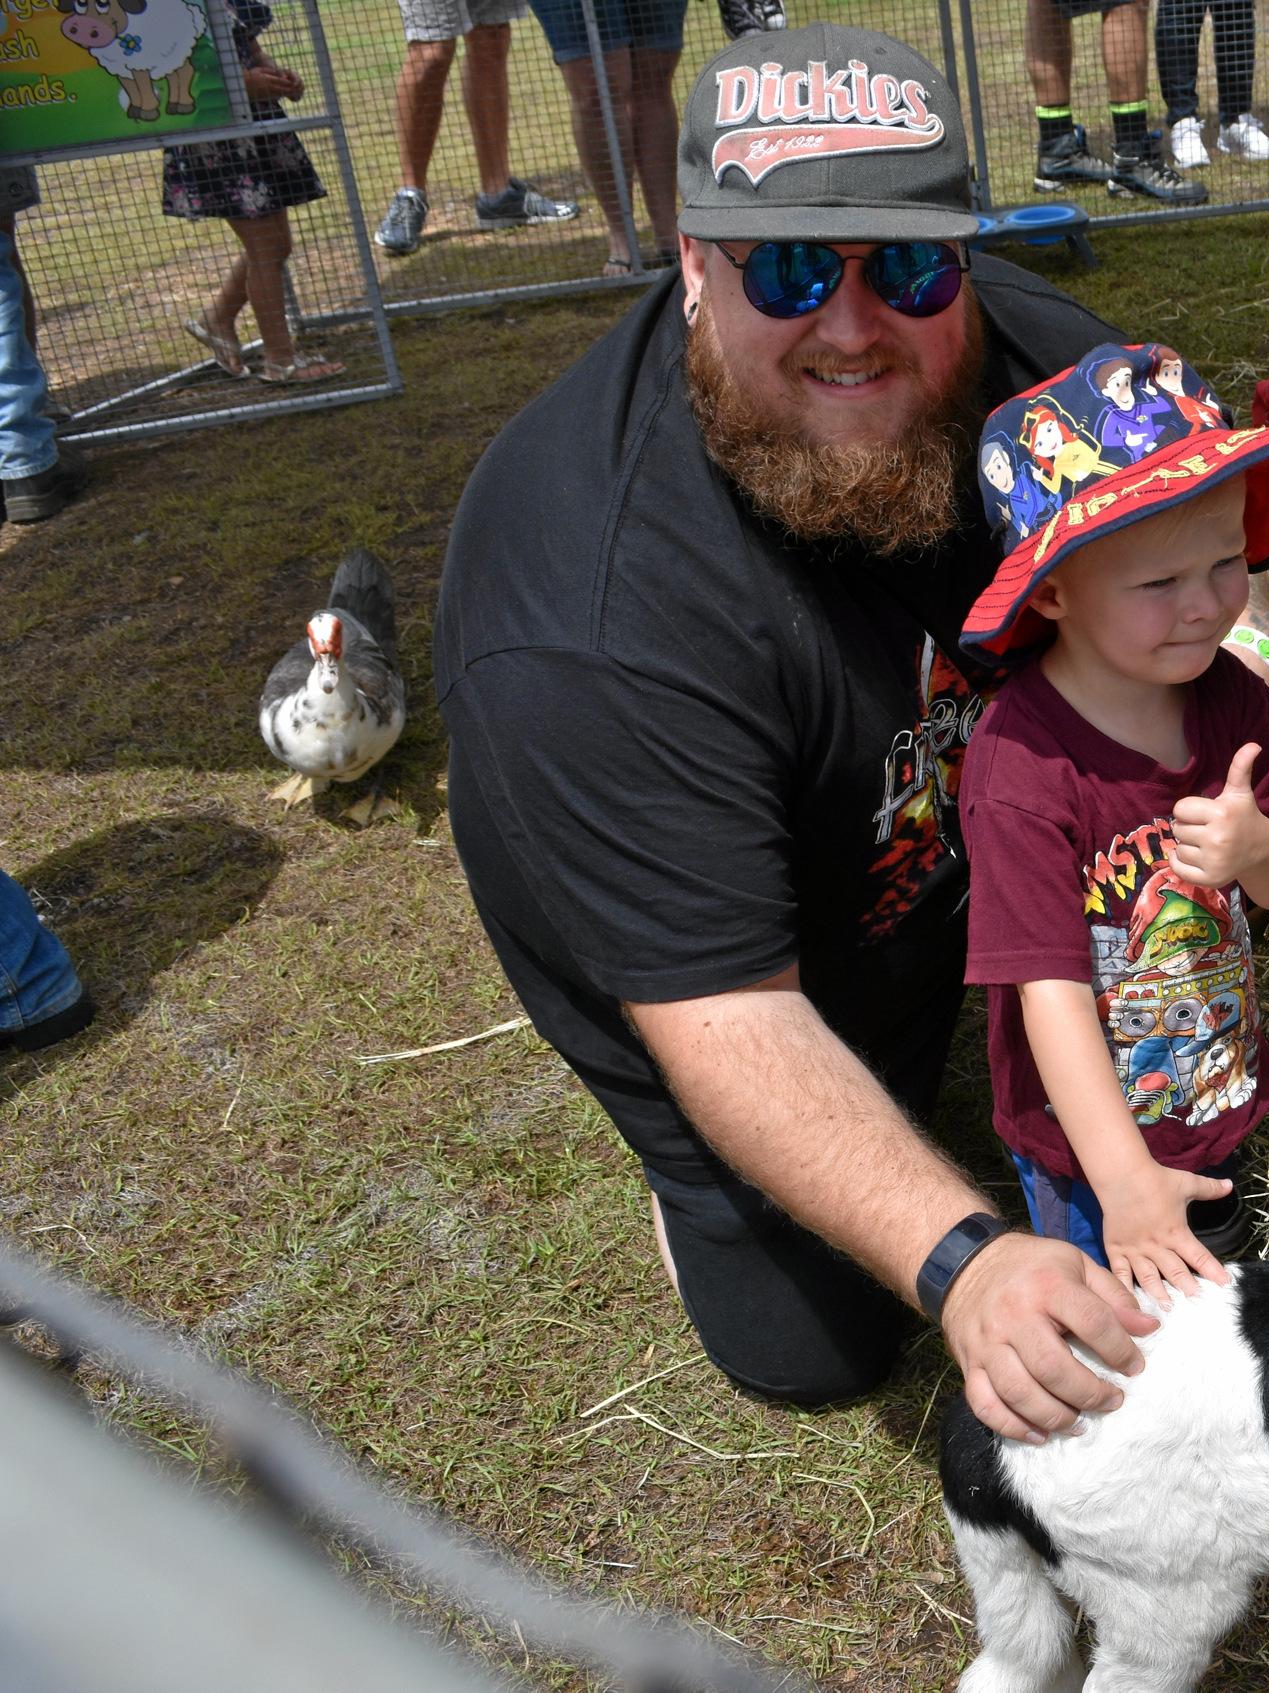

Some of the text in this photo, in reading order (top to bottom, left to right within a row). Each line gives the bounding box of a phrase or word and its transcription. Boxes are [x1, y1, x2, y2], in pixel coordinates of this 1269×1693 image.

[0, 28, 40, 60] sh
[0, 72, 78, 108] ands.
[714, 59, 933, 130] Dickies
